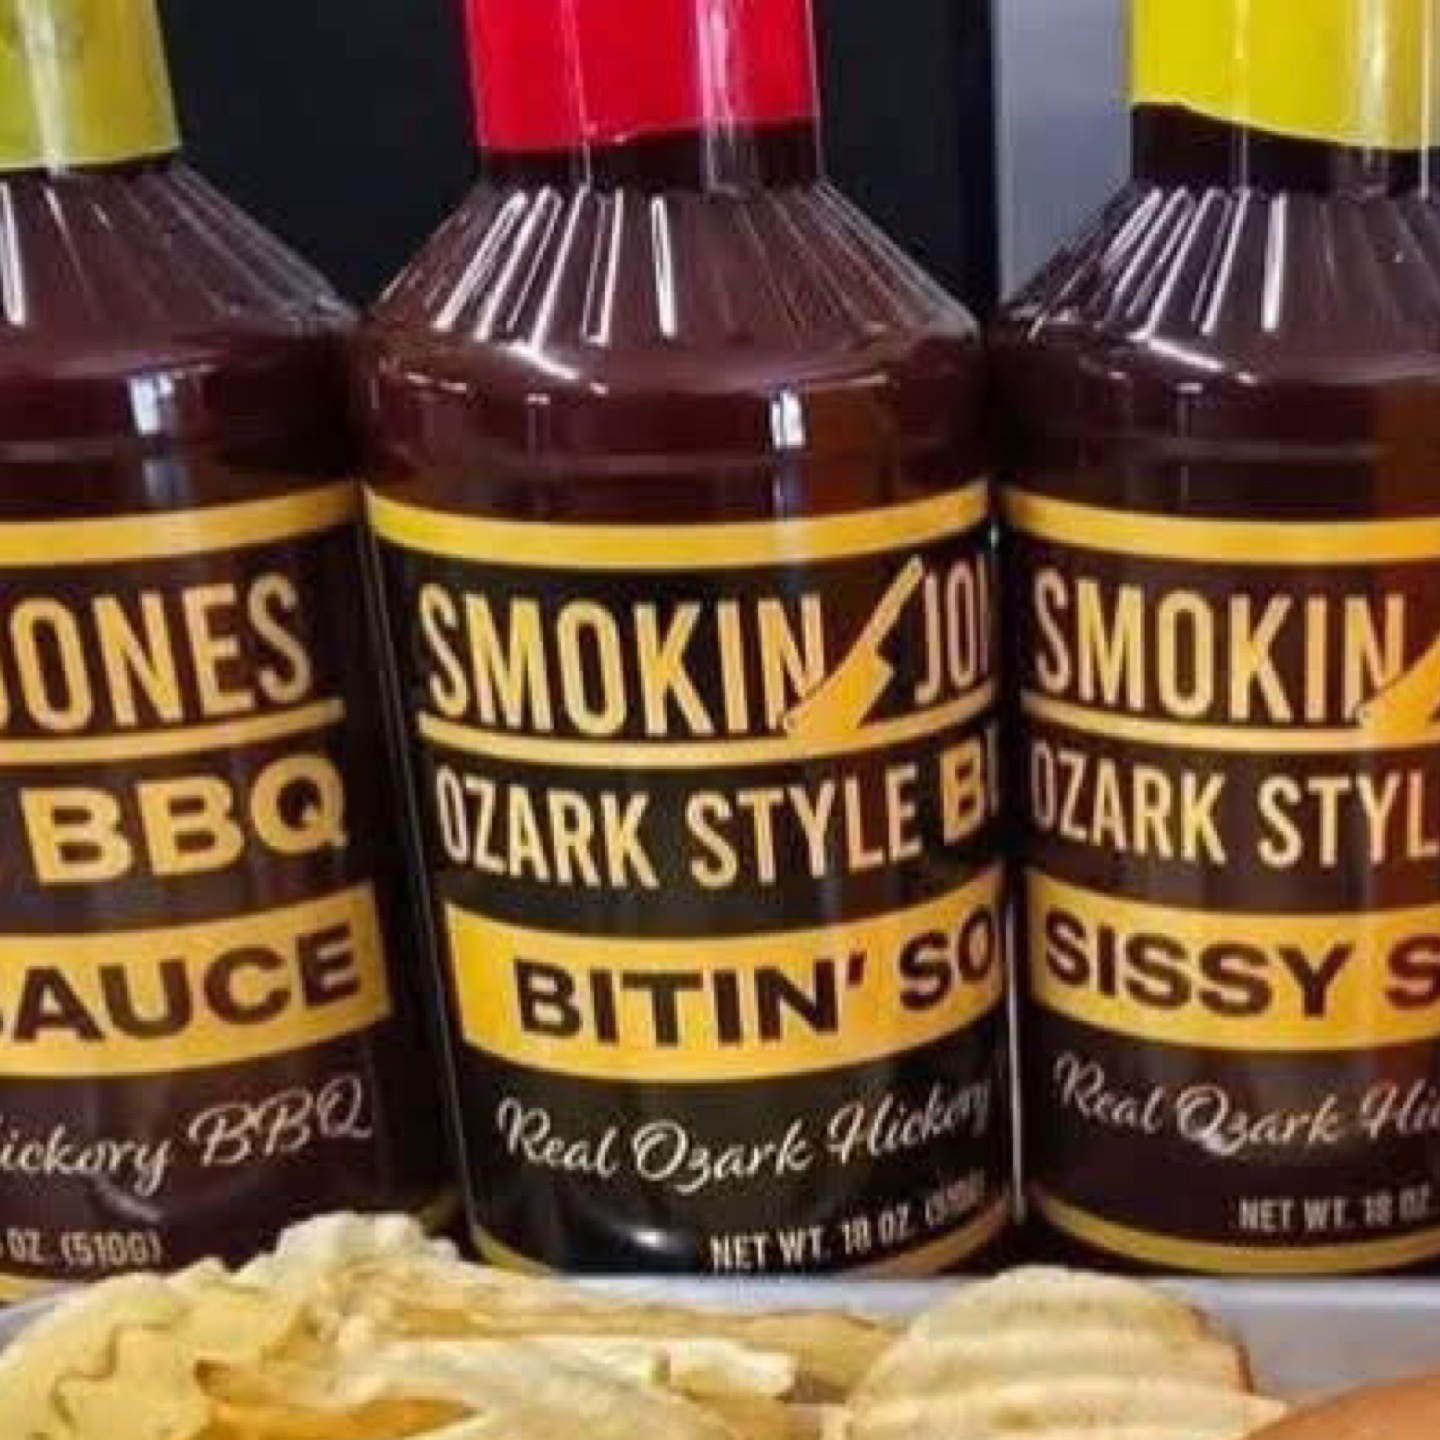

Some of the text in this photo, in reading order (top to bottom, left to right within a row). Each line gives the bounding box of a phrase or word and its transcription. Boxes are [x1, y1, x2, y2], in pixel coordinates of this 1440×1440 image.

[0, 575, 313, 732] ONES
[417, 582, 825, 736] SMOKIN
[1032, 567, 1405, 725] SMOKIN
[19, 753, 349, 887] BBQ
[434, 766, 659, 889] OZARK
[686, 763, 922, 888] STYLE
[1029, 744, 1227, 867] OZARK
[0, 922, 361, 1043] AUCE
[512, 951, 867, 1048] BITIN'
[1044, 906, 1355, 1018] SISSY
[0, 1074, 373, 1197] ickory BBQ
[495, 1097, 618, 1178] Real
[632, 1117, 813, 1194] Ozark
[1053, 1051, 1164, 1133] Real
[1174, 1084, 1343, 1157] Ozark
[709, 1231, 769, 1270] NET
[1239, 1196, 1294, 1233] NET
